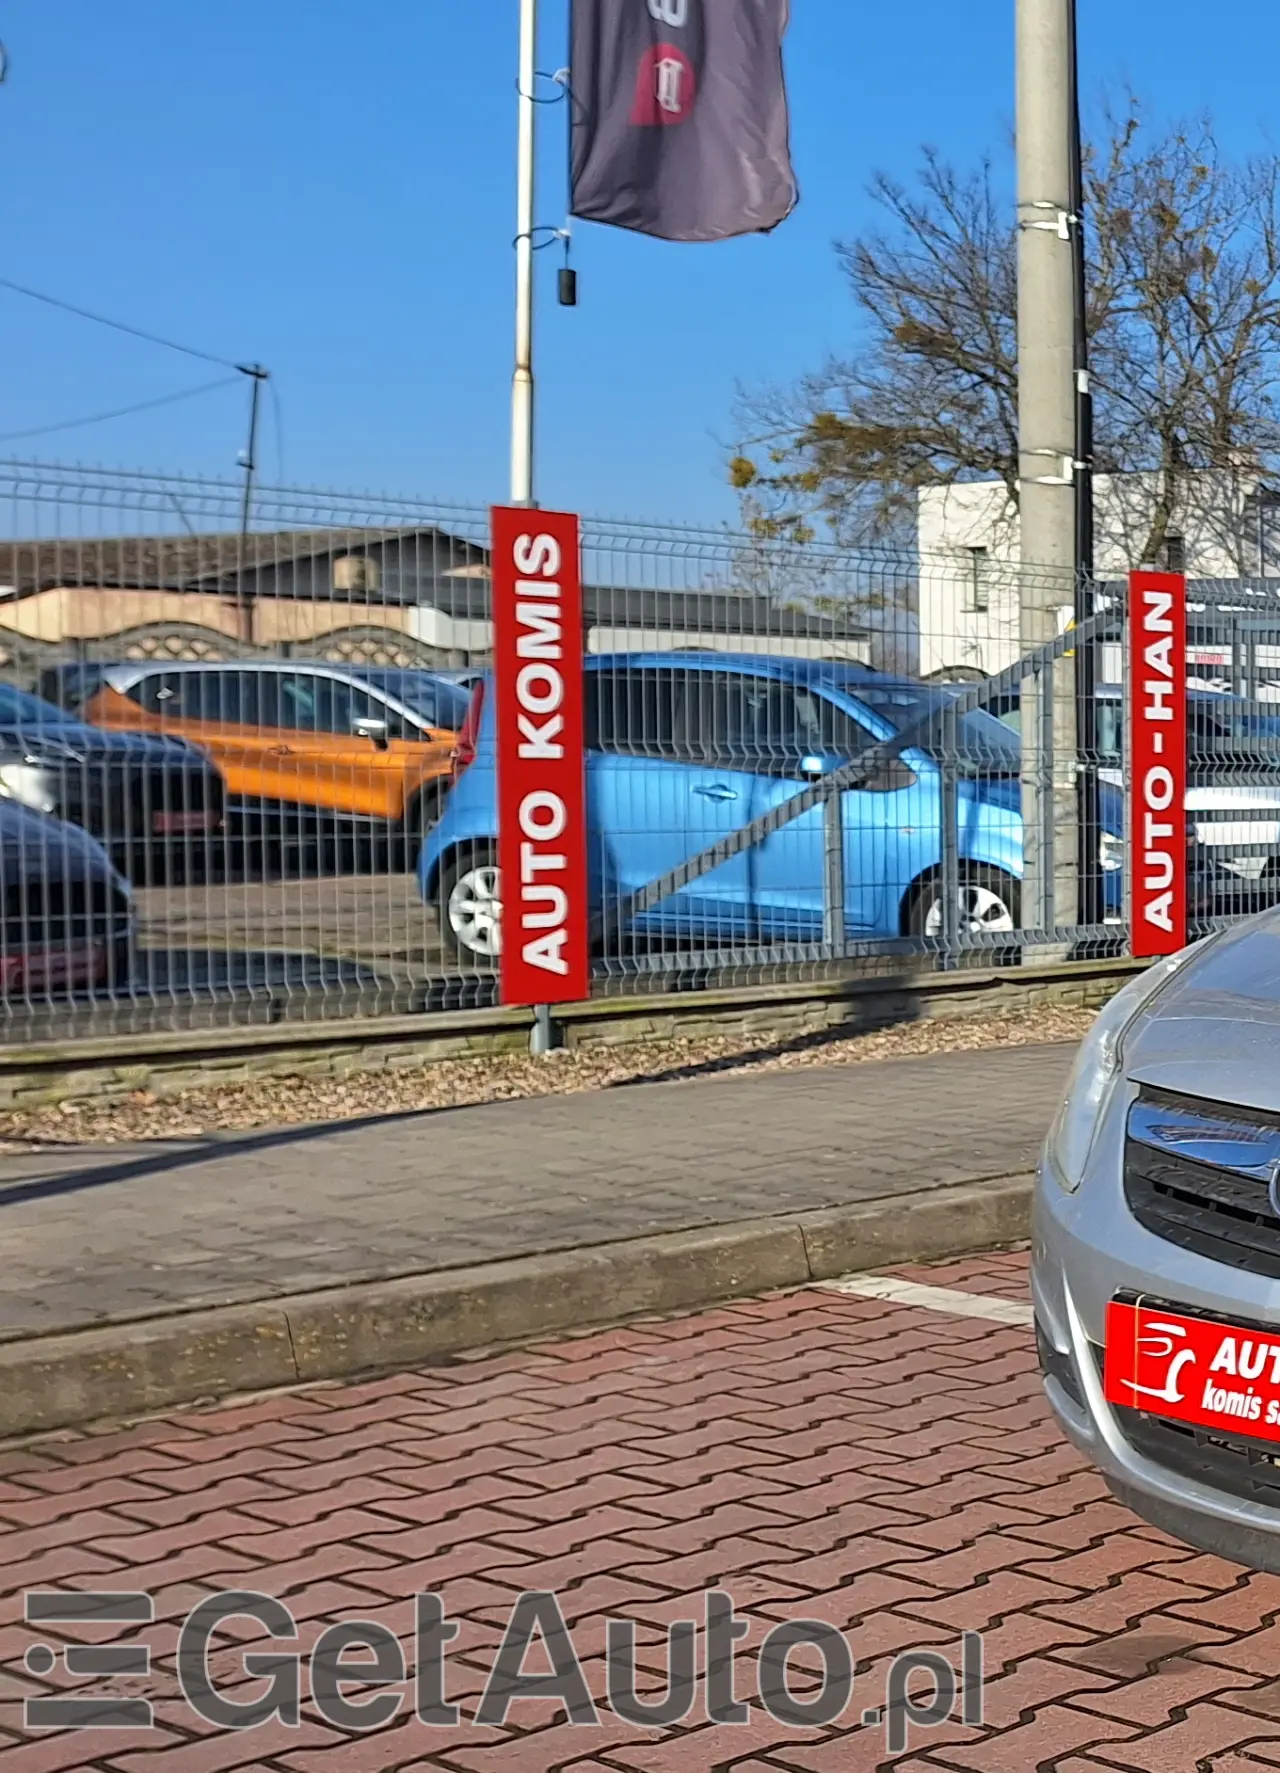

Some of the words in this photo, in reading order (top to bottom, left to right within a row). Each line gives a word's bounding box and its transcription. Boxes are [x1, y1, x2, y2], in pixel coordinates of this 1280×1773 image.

[513, 532, 564, 760] KOMIS
[518, 790, 569, 976] AUTO
[1201, 1378, 1262, 1421] komis
